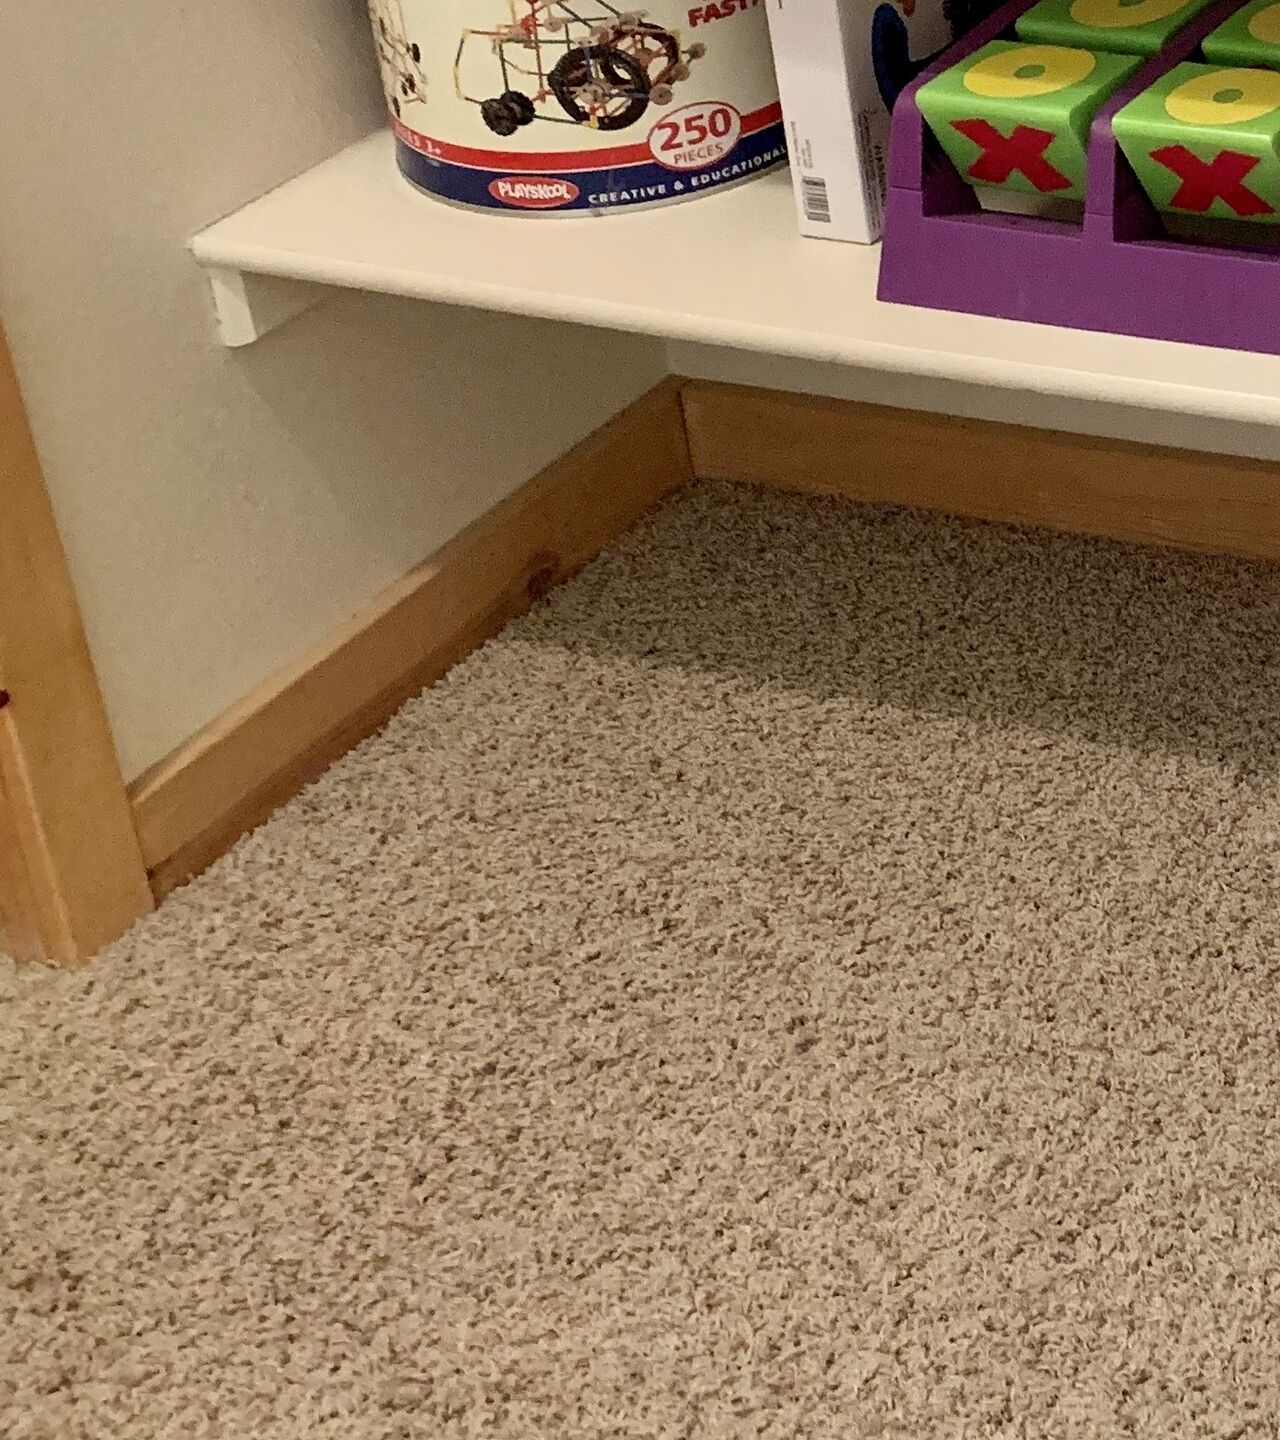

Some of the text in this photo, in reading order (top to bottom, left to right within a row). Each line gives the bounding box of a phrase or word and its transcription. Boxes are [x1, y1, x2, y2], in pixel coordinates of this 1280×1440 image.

[656, 108, 731, 152] 250
[673, 142, 724, 164] PIECES
[498, 181, 571, 200] PLAYSKOOL
[588, 184, 668, 204] CREATIVE
